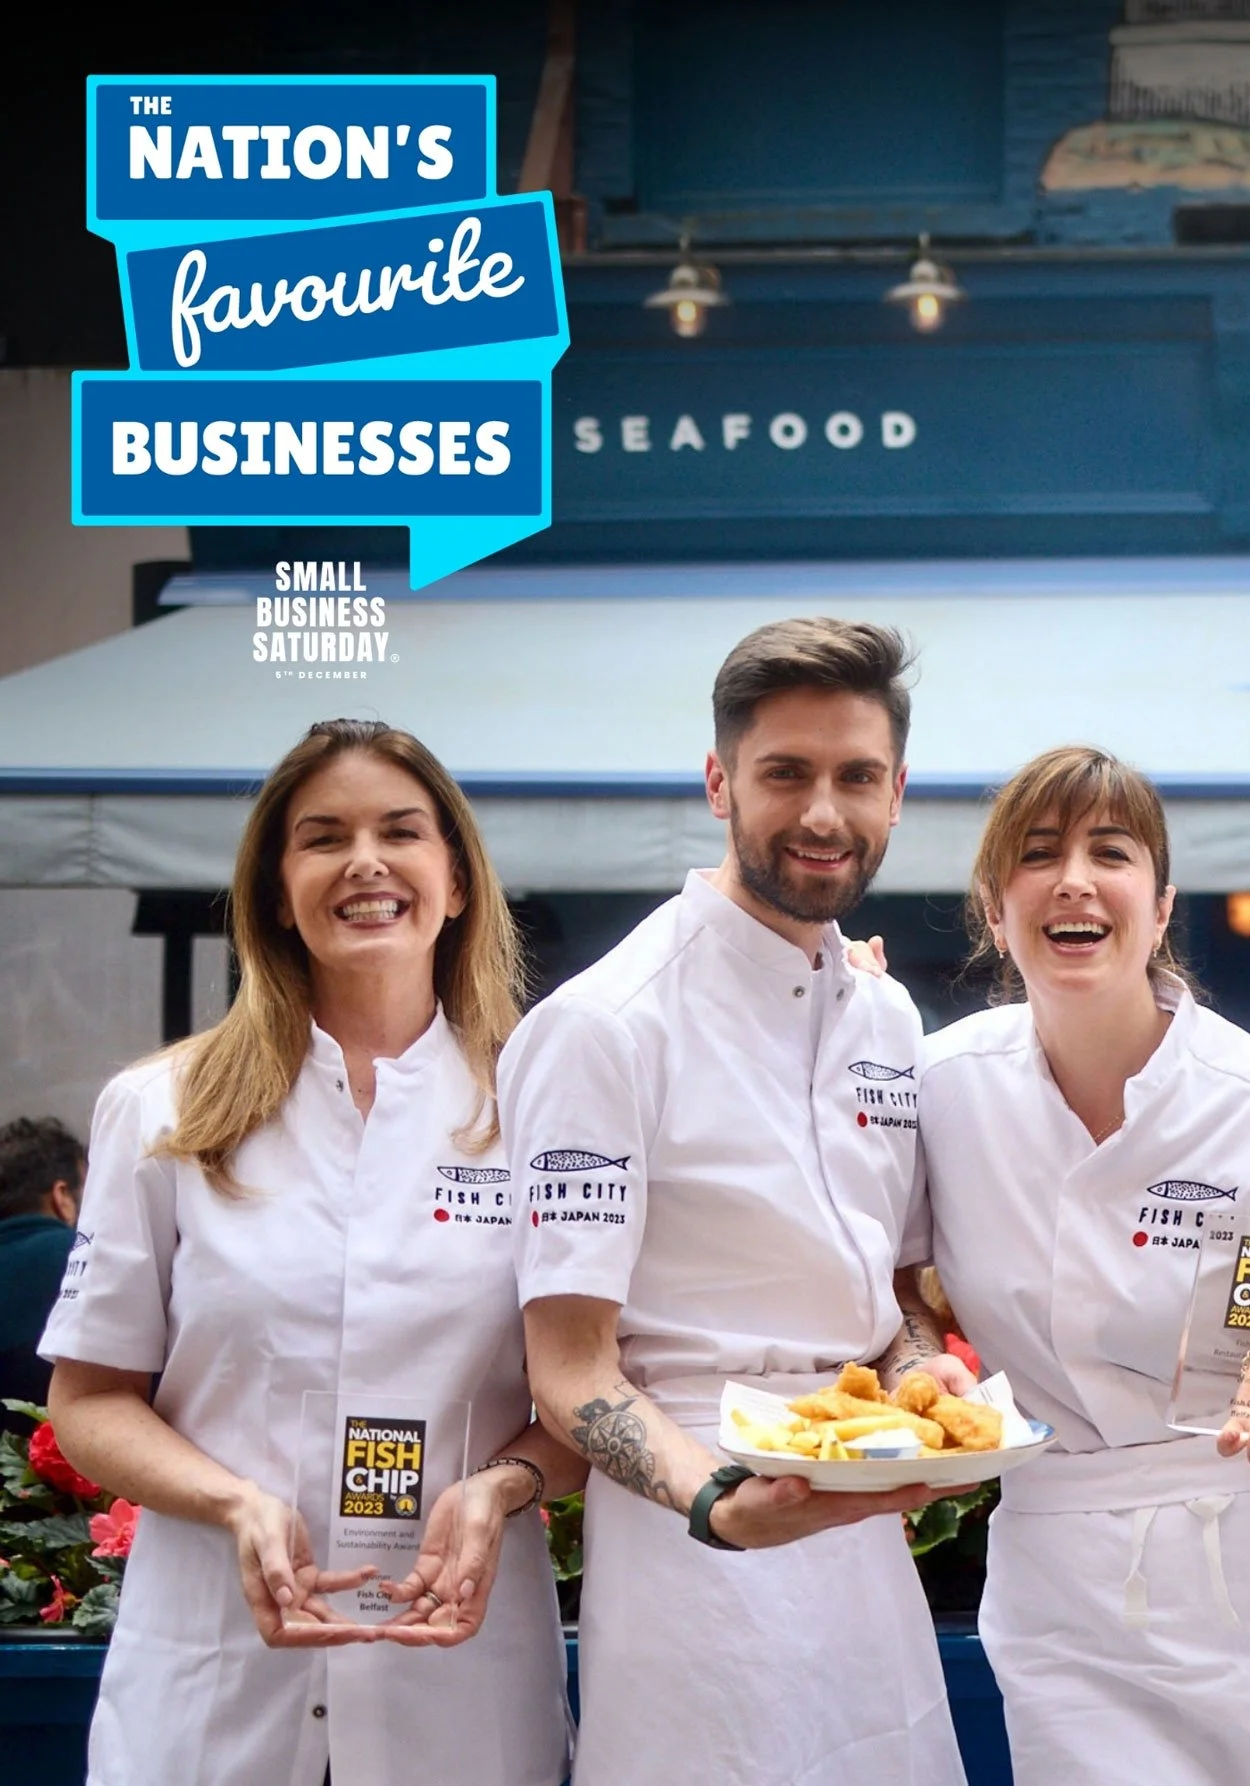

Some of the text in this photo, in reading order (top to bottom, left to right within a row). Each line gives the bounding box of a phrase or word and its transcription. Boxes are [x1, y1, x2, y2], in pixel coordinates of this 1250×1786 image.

[573, 410, 917, 453] SEAFOOD
[856, 1088, 917, 1108] FISH CITY
[880, 1117, 902, 1127] JAPAN
[435, 1187, 480, 1206] FISH
[530, 1183, 626, 1202] FISH CITY
[561, 1211, 600, 1222] JAPAN
[604, 1212, 625, 1224] 2023
[1138, 1207, 1182, 1226] FISH
[1172, 1238, 1200, 1249] JAPA
[1209, 1231, 1234, 1241] 2023
[352, 1420, 367, 1428] THE
[349, 1428, 422, 1443] NATIONAL
[347, 1440, 422, 1470] FISH
[346, 1467, 420, 1494] CHIP
[345, 1493, 384, 1501] AWARDS
[344, 1501, 384, 1515] 2023
[344, 1528, 415, 1538] Environment and
[336, 1540, 392, 1550] Sustainability
[357, 1590, 392, 1600] Fish City
[360, 1602, 388, 1612] Belfast
